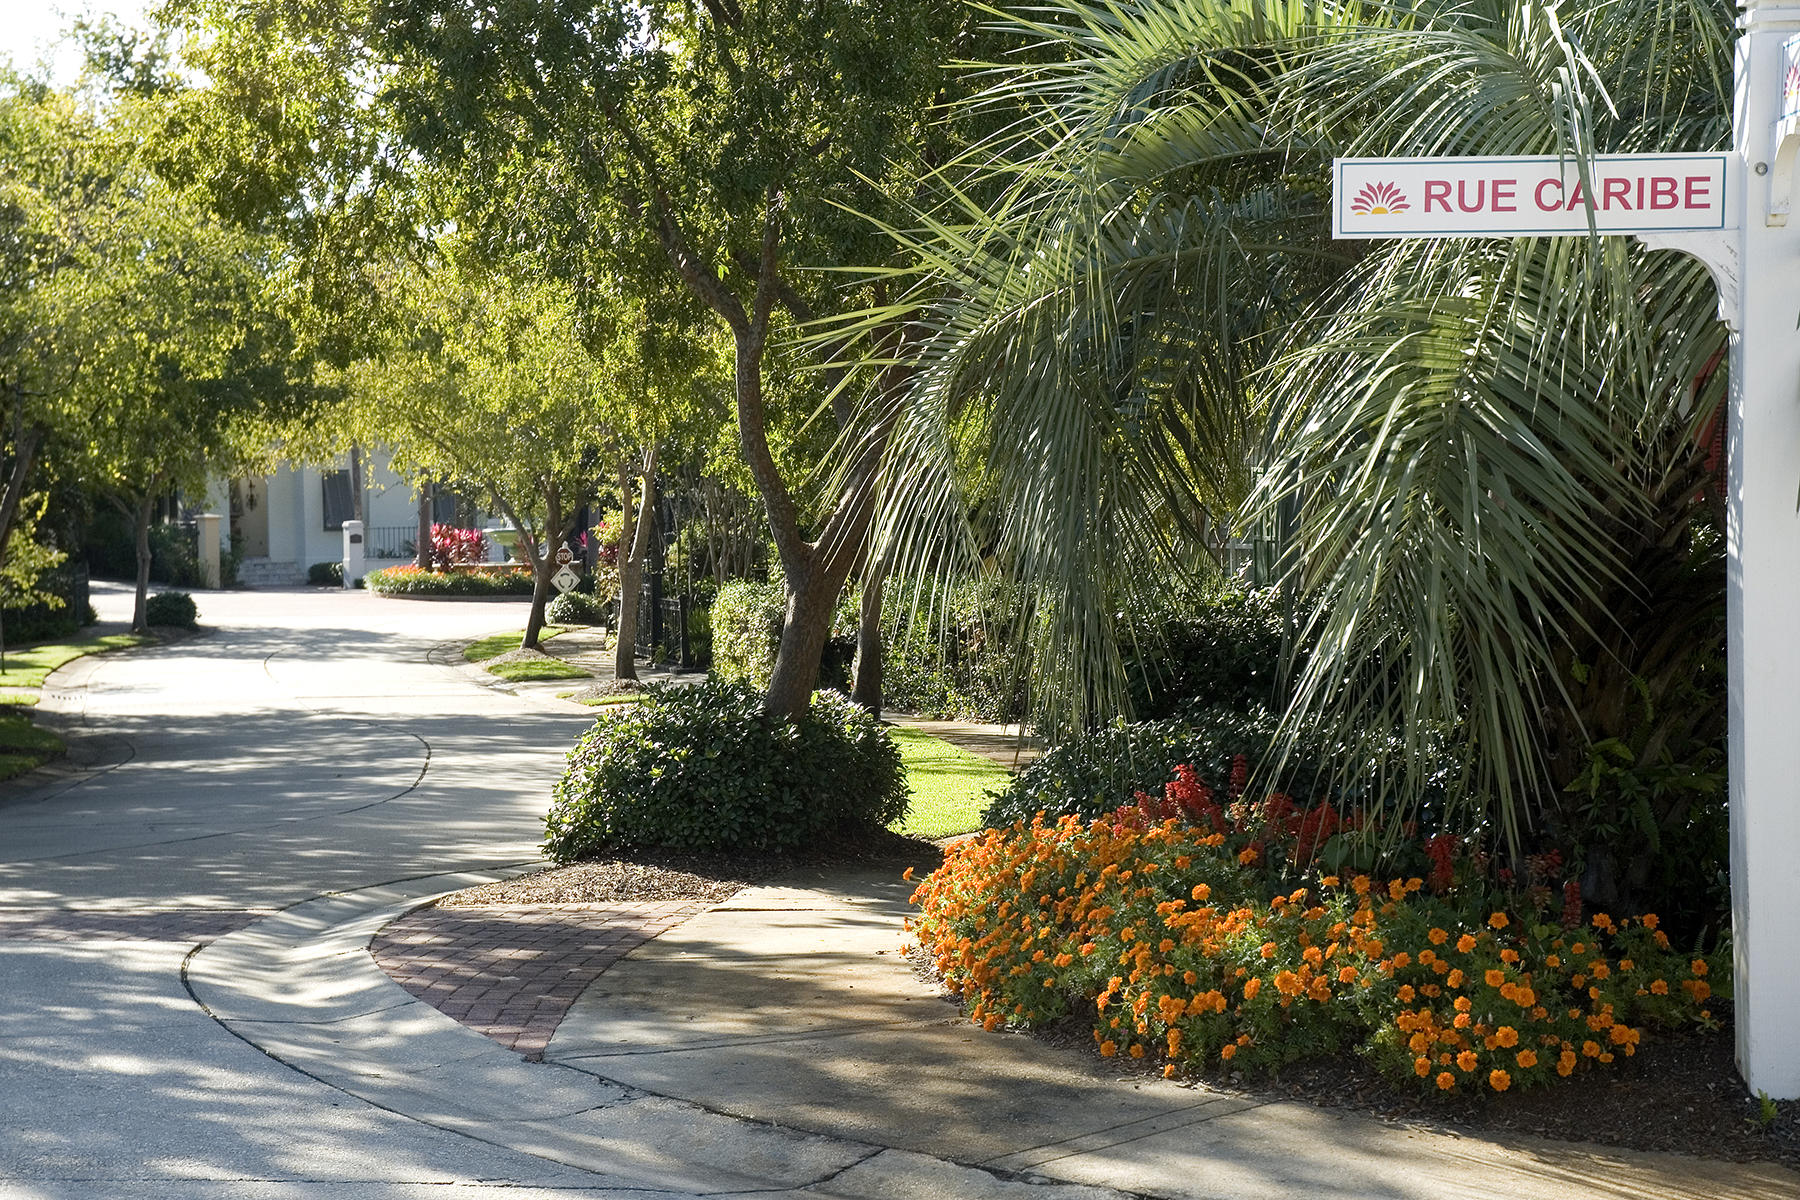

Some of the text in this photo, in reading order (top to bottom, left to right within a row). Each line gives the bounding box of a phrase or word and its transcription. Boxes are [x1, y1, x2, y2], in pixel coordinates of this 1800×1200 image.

[1424, 176, 1711, 213] RUE CARIBE
[556, 552, 572, 561] STOP
